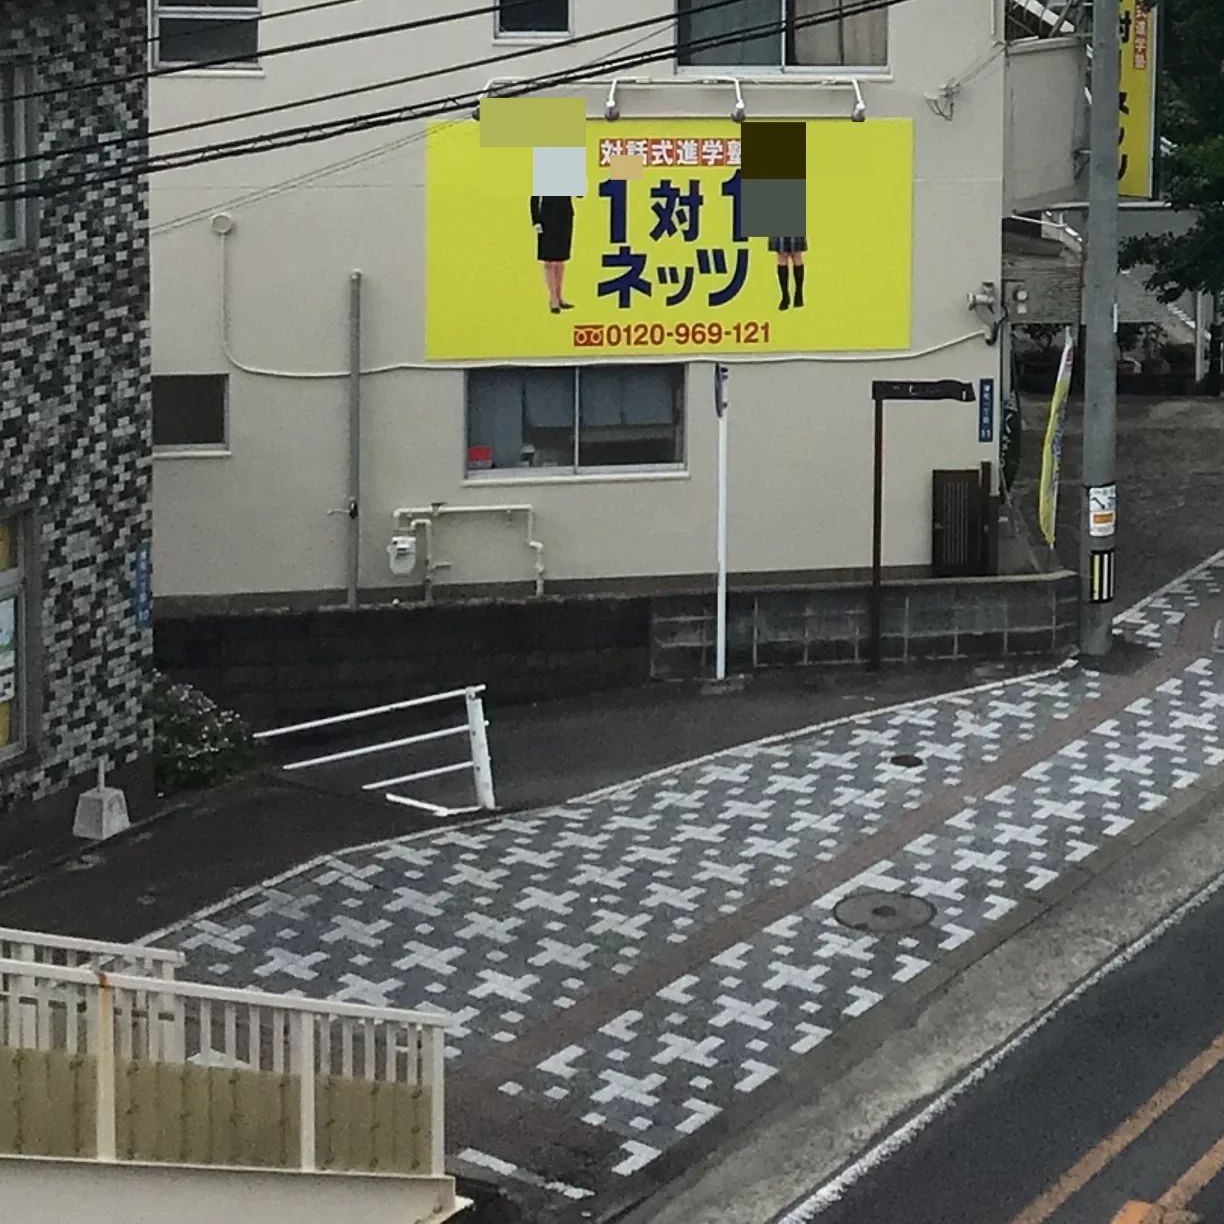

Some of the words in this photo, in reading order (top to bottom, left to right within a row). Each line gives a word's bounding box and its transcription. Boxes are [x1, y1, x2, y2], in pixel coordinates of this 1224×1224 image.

[597, 246, 749, 309] ネッツ
[606, 322, 770, 346] 0120-969-121
